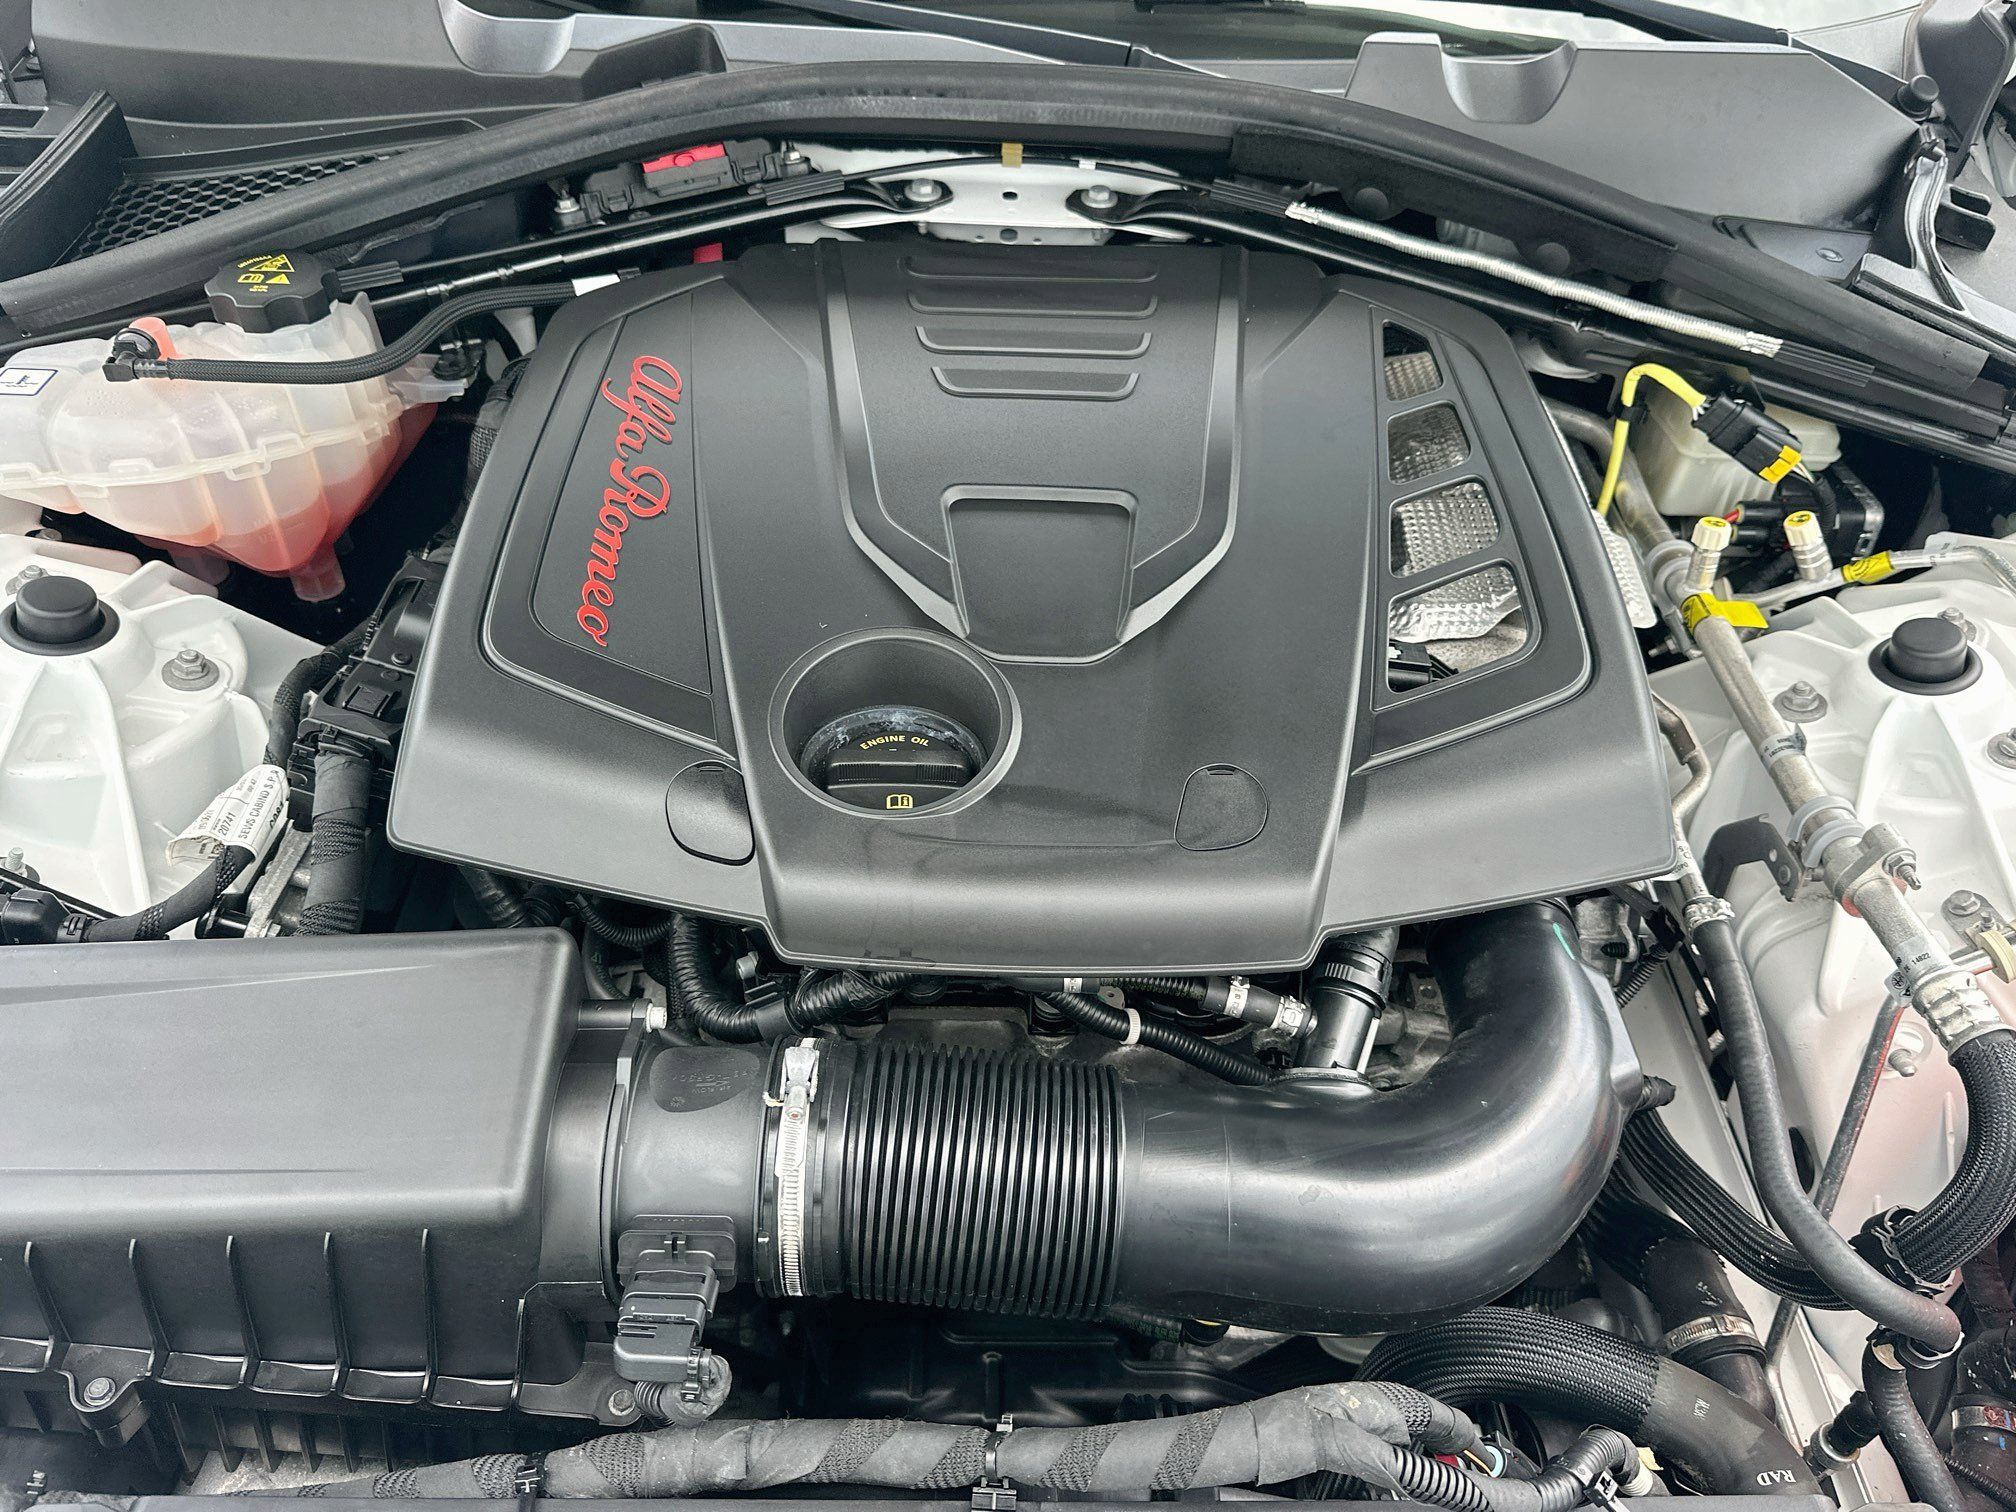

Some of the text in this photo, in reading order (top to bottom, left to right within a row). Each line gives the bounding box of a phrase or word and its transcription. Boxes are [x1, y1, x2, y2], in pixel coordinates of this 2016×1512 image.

[577, 355, 682, 647] Alfa Romeo
[859, 735, 930, 750] ENGINE OIL
[218, 812, 236, 836] 20741
[238, 818, 256, 839] SEWS
[250, 790, 270, 817] CABIND
[1756, 1469, 1797, 1486] RAD
